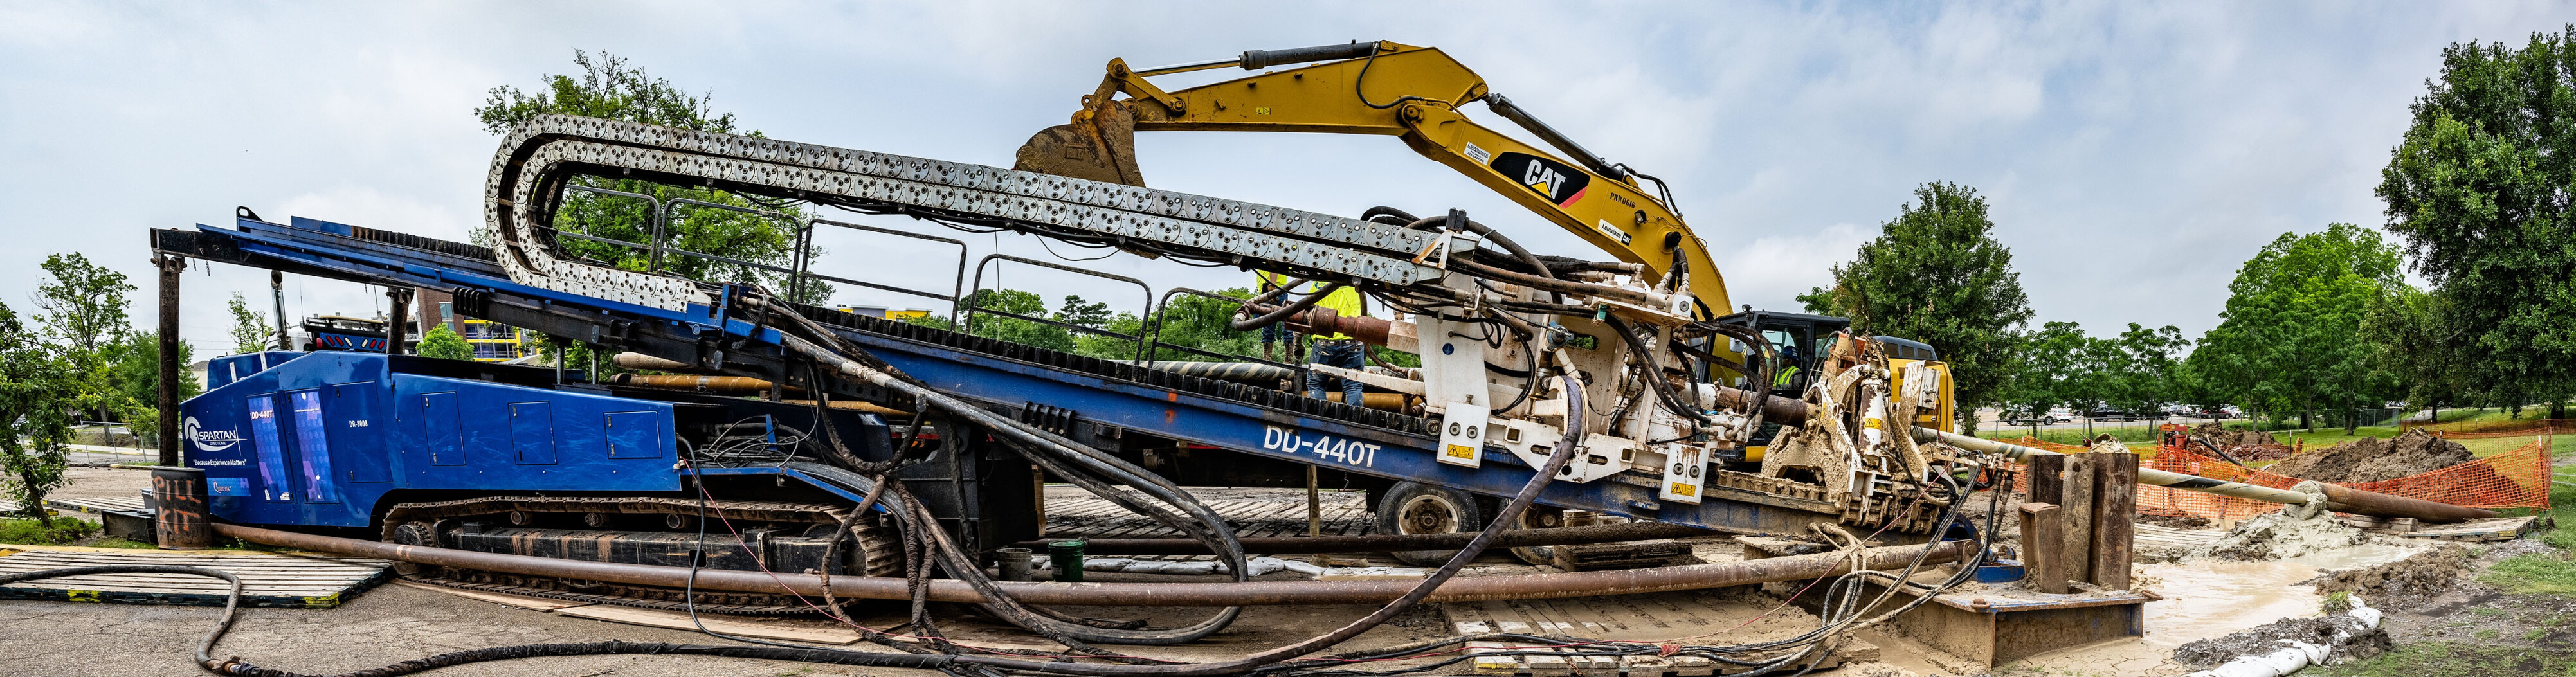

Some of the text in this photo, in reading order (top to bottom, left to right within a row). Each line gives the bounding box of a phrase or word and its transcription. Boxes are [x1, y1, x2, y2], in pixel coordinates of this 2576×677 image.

[1524, 159, 1566, 199] CAT
[1610, 192, 1635, 209] PNW0616
[1602, 223, 1631, 244] Louisiana CAT
[251, 410, 273, 420] DD-440T
[199, 430, 237, 440] SPARTAN
[1264, 425, 1381, 467] DD-440T
[210, 459, 230, 467] Experience
[153, 476, 201, 503] PILL
[159, 506, 201, 534] KIT
